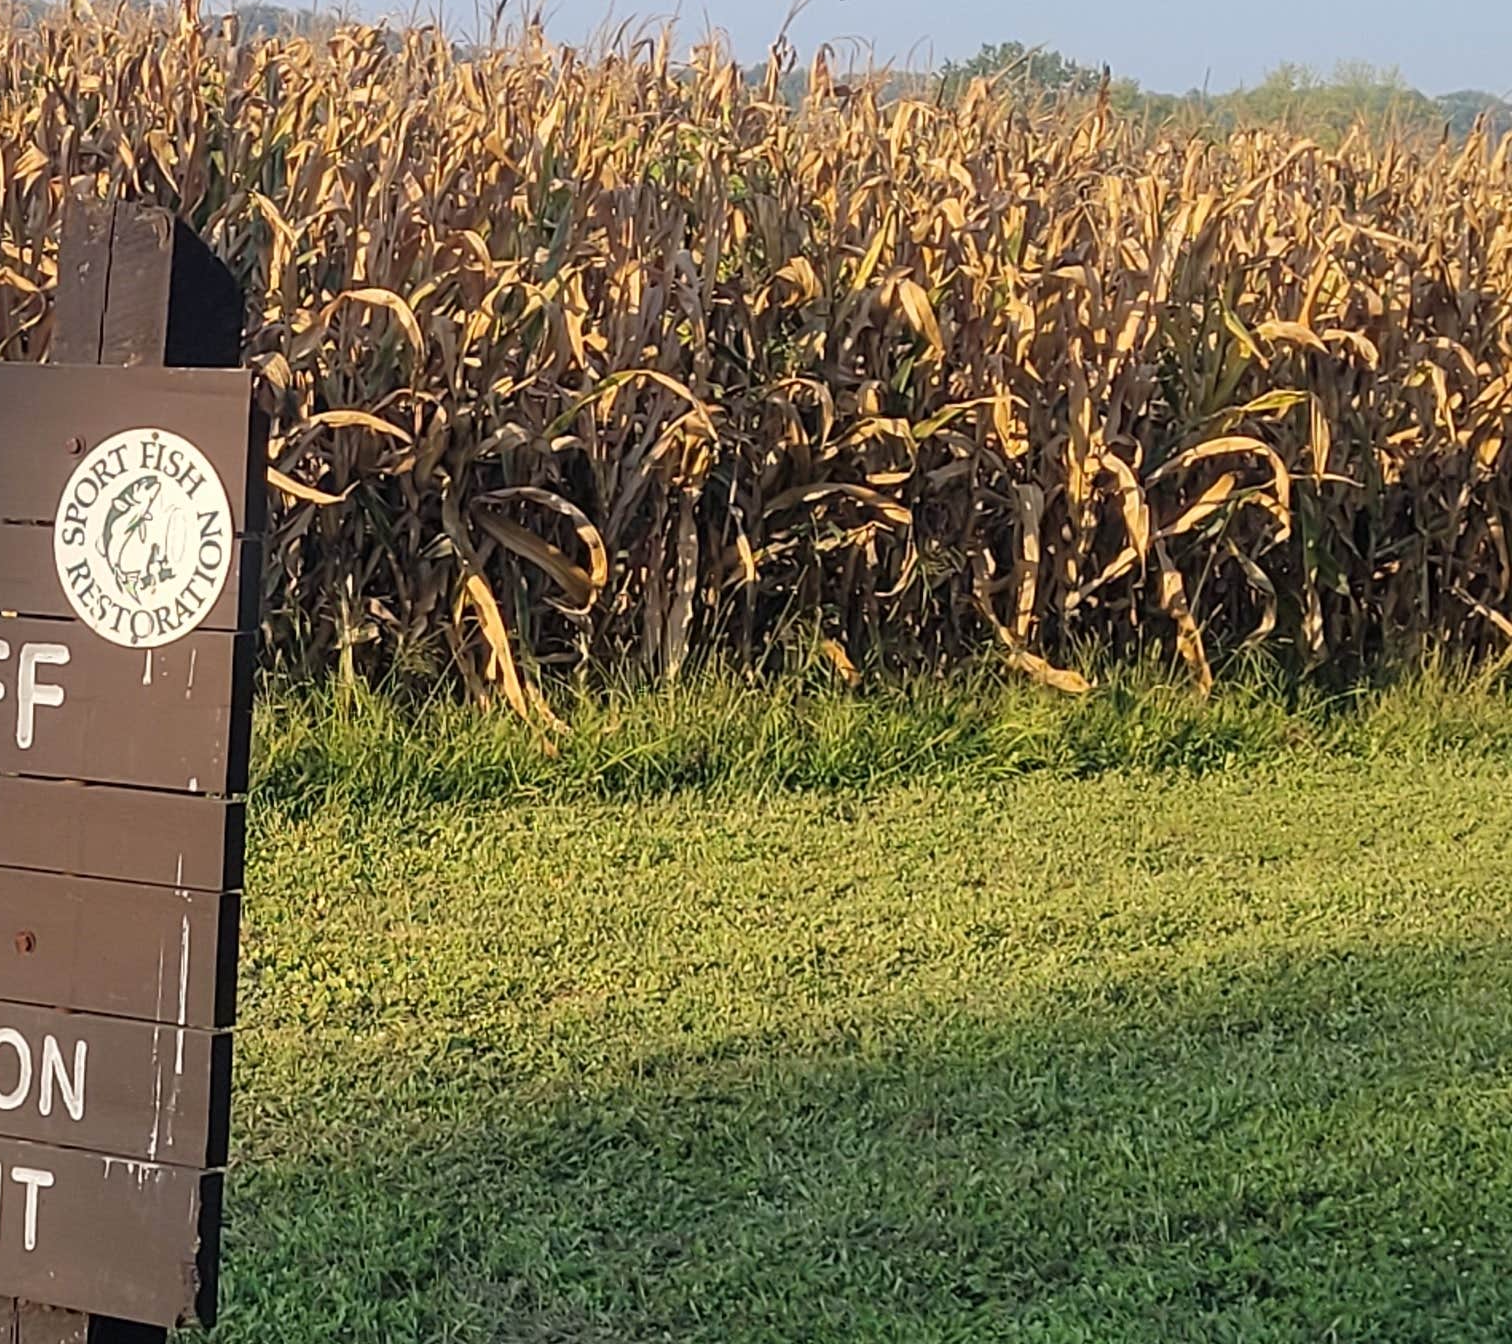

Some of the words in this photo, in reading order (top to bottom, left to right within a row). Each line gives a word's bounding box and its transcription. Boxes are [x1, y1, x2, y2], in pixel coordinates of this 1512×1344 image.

[62, 444, 130, 547] SPORT
[138, 439, 208, 500] FISH
[65, 509, 224, 640] RESTORATION
